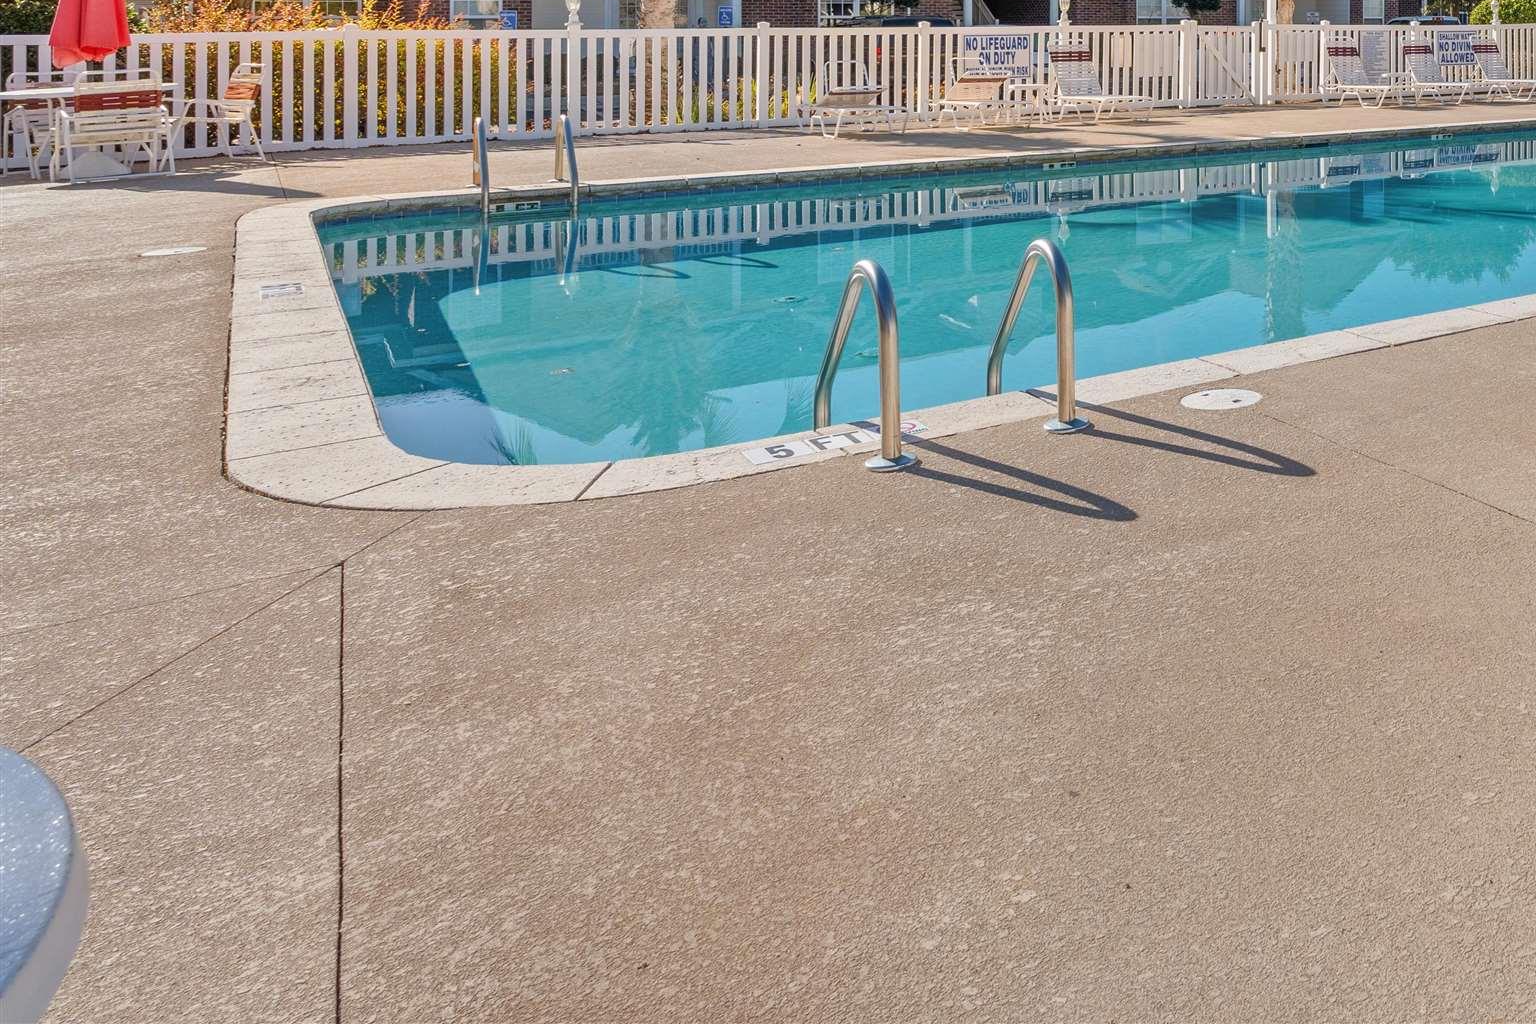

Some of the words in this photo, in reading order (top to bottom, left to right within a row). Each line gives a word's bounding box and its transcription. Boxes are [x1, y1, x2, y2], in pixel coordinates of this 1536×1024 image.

[965, 37, 978, 51] NO
[980, 36, 1029, 50] LIFEGUARD
[1439, 41, 1450, 52] NO
[1451, 41, 1472, 52] DIVIN
[979, 51, 991, 65] ON
[993, 51, 1016, 65] DUTY
[1440, 52, 1475, 63] ALLOWED
[1016, 66, 1029, 76] RISK
[764, 444, 795, 459] 5
[808, 431, 861, 451] FT
